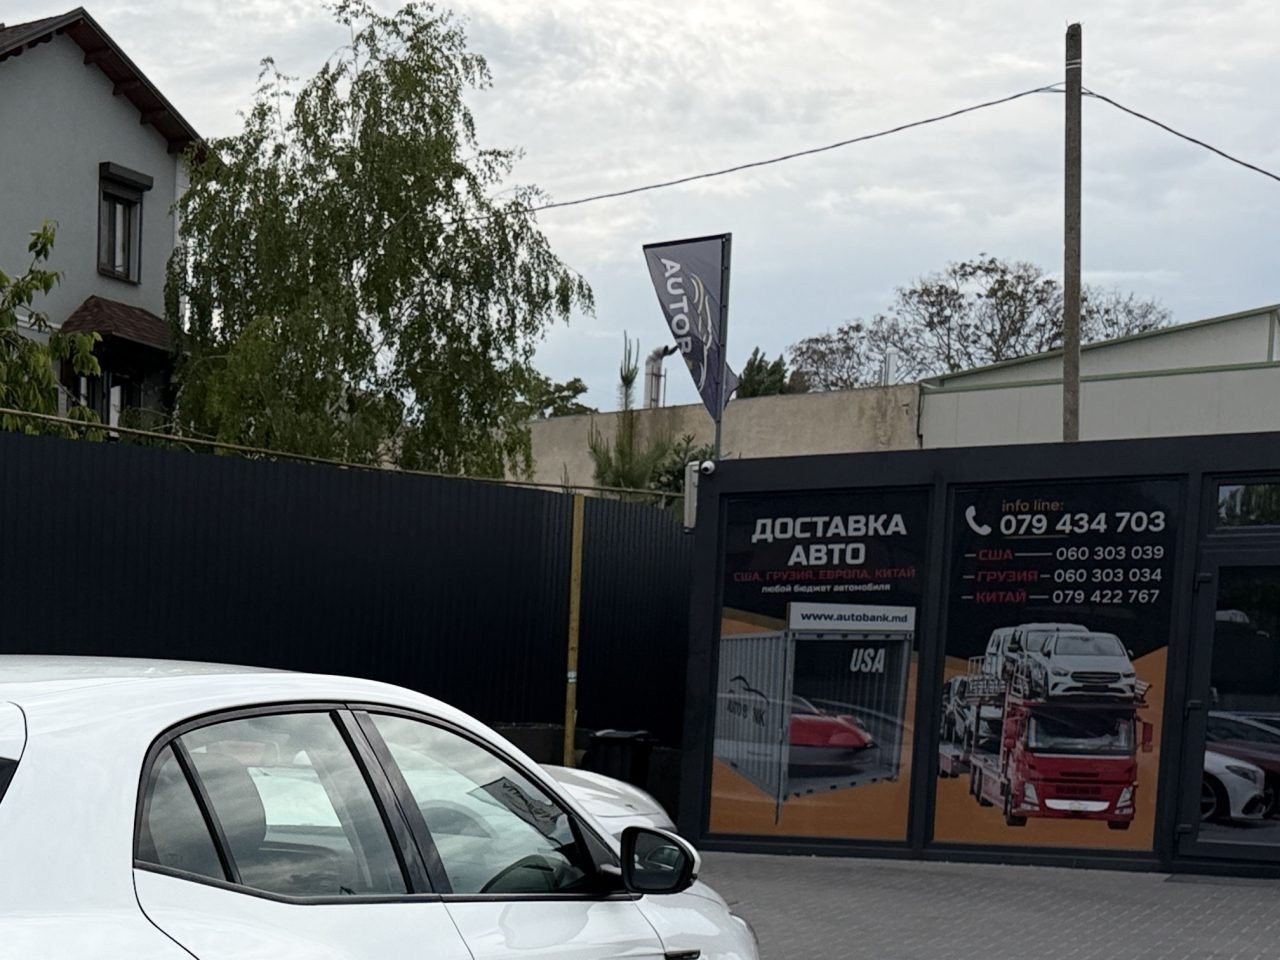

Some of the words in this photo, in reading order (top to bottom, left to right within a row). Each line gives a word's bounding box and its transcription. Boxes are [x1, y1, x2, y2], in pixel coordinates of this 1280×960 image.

[1001, 499, 1029, 512] info
[1033, 499, 1064, 511] line:
[751, 513, 908, 544] ДОСТАВКА
[999, 514, 1048, 535] 079
[1055, 512, 1108, 534] 434
[1114, 510, 1166, 533] 703
[787, 542, 866, 567] АВТО
[1055, 547, 1089, 561] 060
[1093, 546, 1126, 560] 303
[1130, 545, 1165, 559] 039
[874, 566, 916, 579] КИТАЙ
[976, 570, 1039, 583] ГРУЗИЯ
[1053, 569, 1087, 583] 060
[1091, 568, 1124, 582] 303
[1128, 567, 1162, 582] 034
[761, 584, 792, 594] любой
[793, 584, 831, 593] бюджет
[833, 583, 891, 593] автомобиля
[975, 588, 1027, 603] КИТАЙ
[1051, 590, 1085, 604] 079
[1090, 589, 1123, 603] 422
[1127, 589, 1160, 603] 767
[800, 611, 909, 624] www.autobank.md
[849, 648, 885, 674] USA
